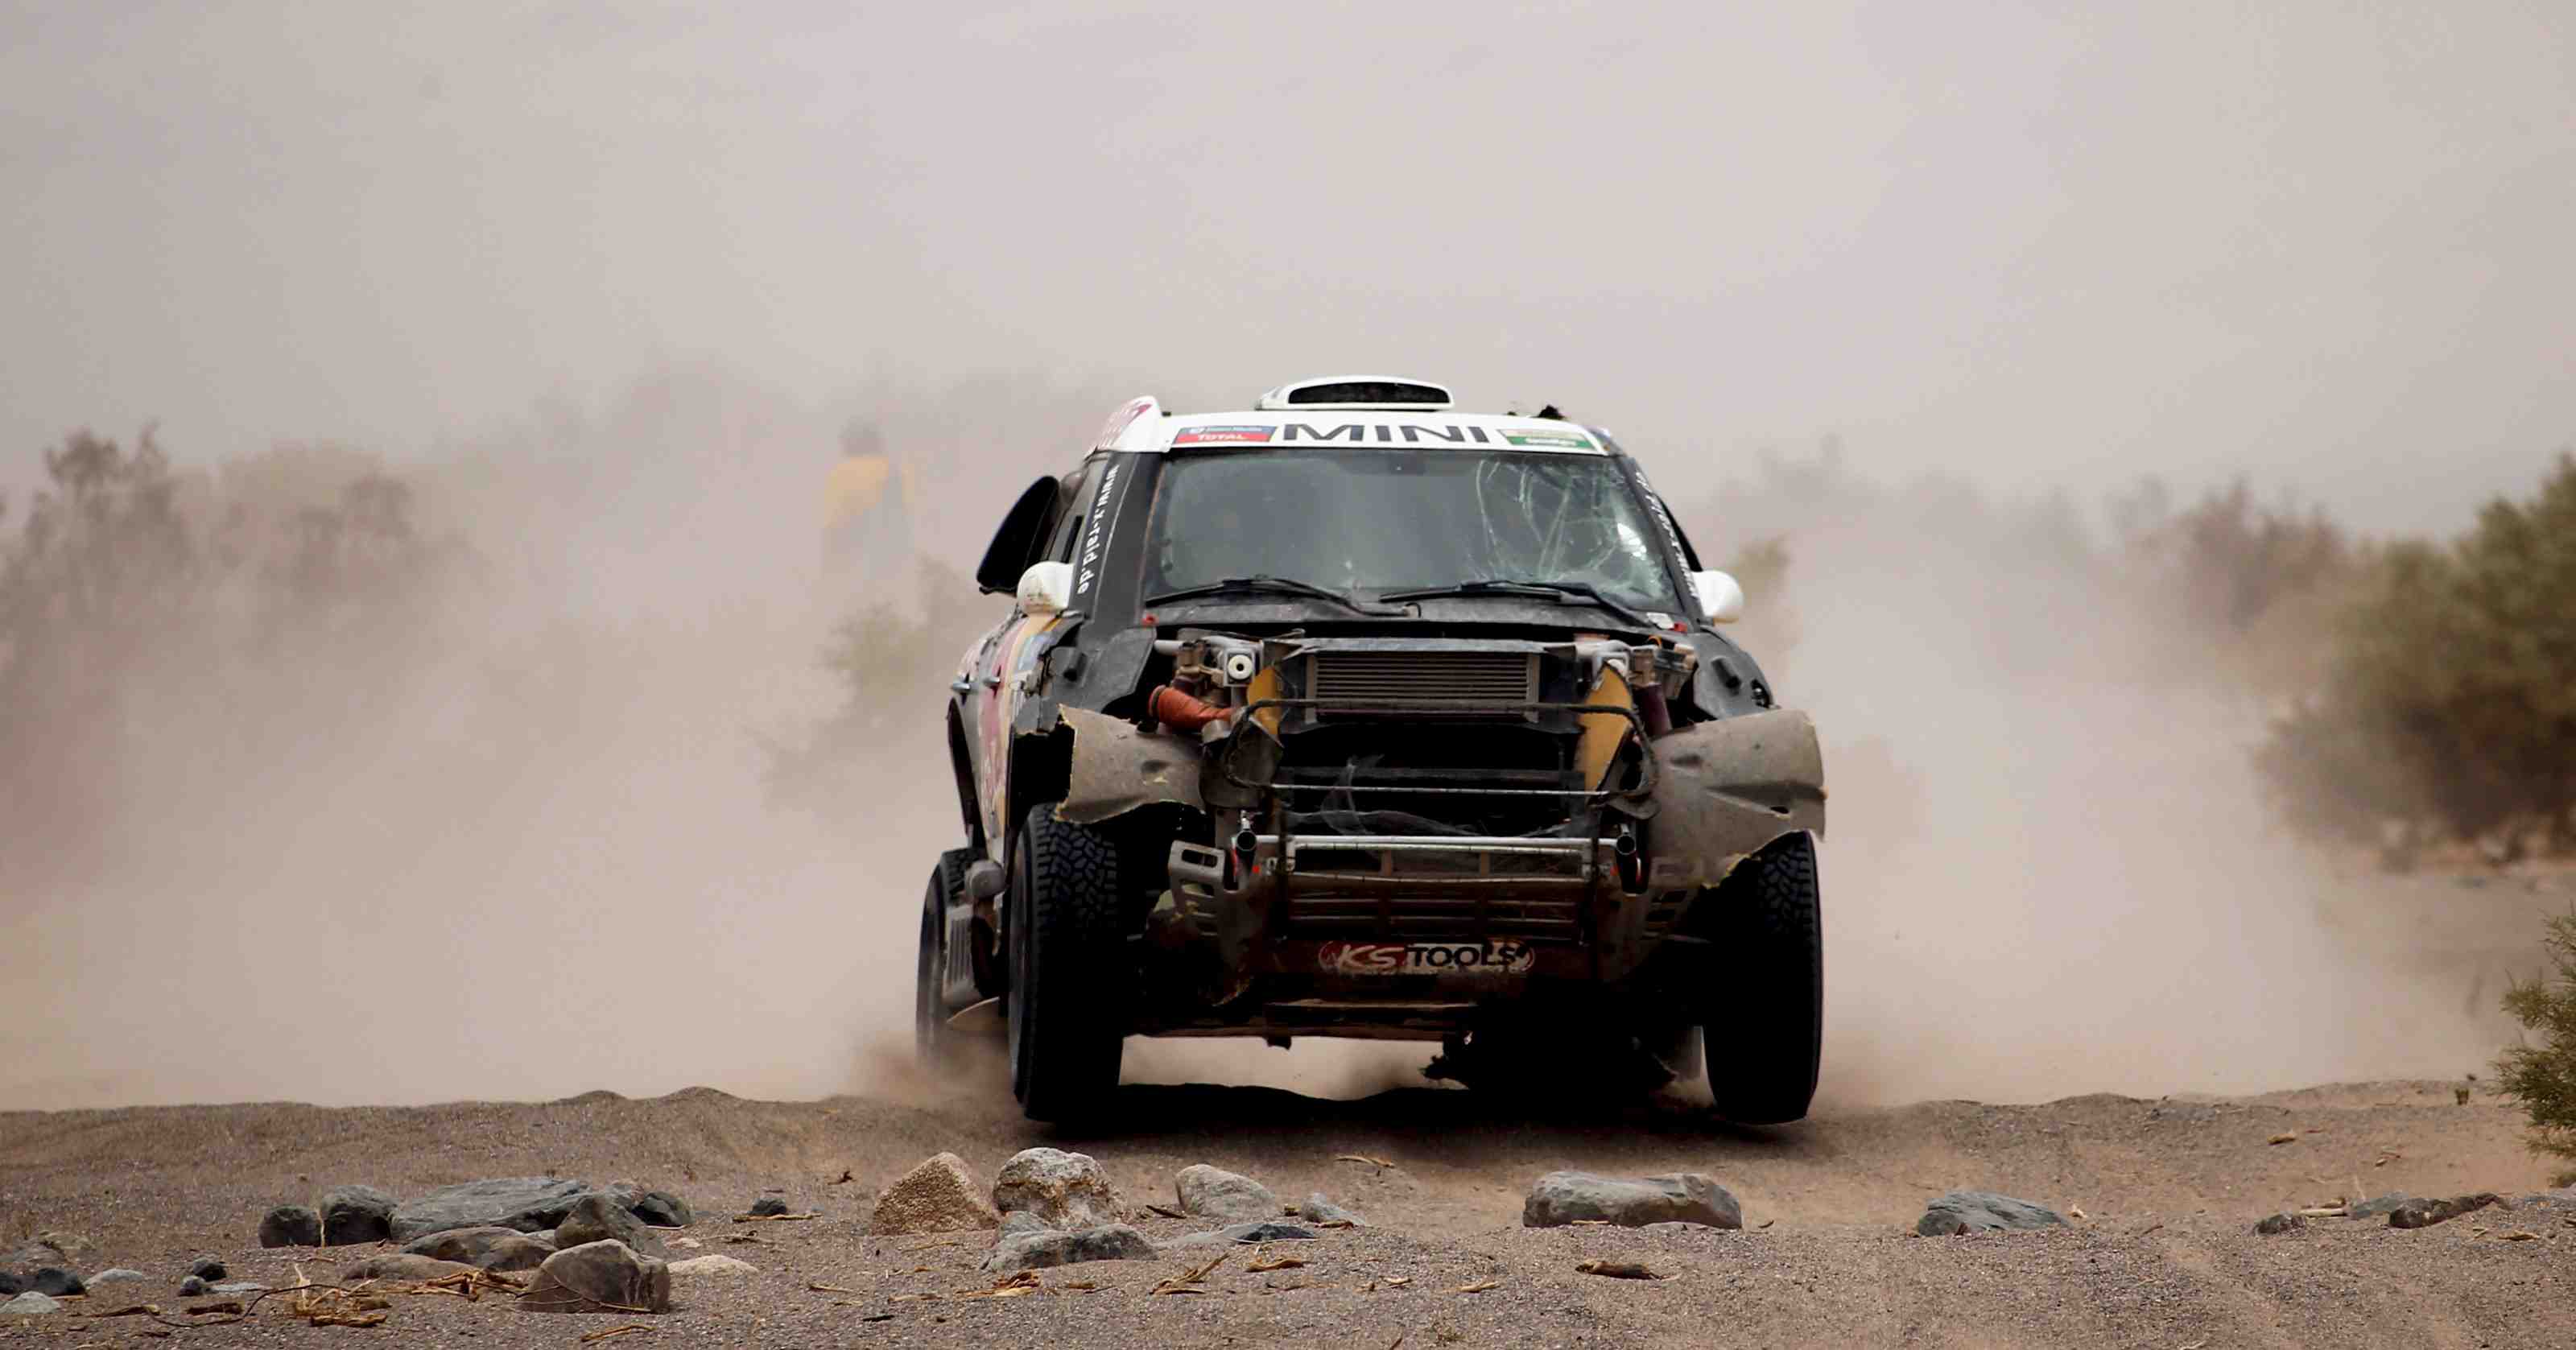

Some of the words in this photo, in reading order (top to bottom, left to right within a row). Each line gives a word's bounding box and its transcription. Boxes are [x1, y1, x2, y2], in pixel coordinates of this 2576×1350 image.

[1283, 423, 1490, 443] MINI
[1077, 464, 1120, 594] www.x-raid.de
[1338, 943, 1405, 968] KS
[1405, 943, 1518, 967] TOOLS
